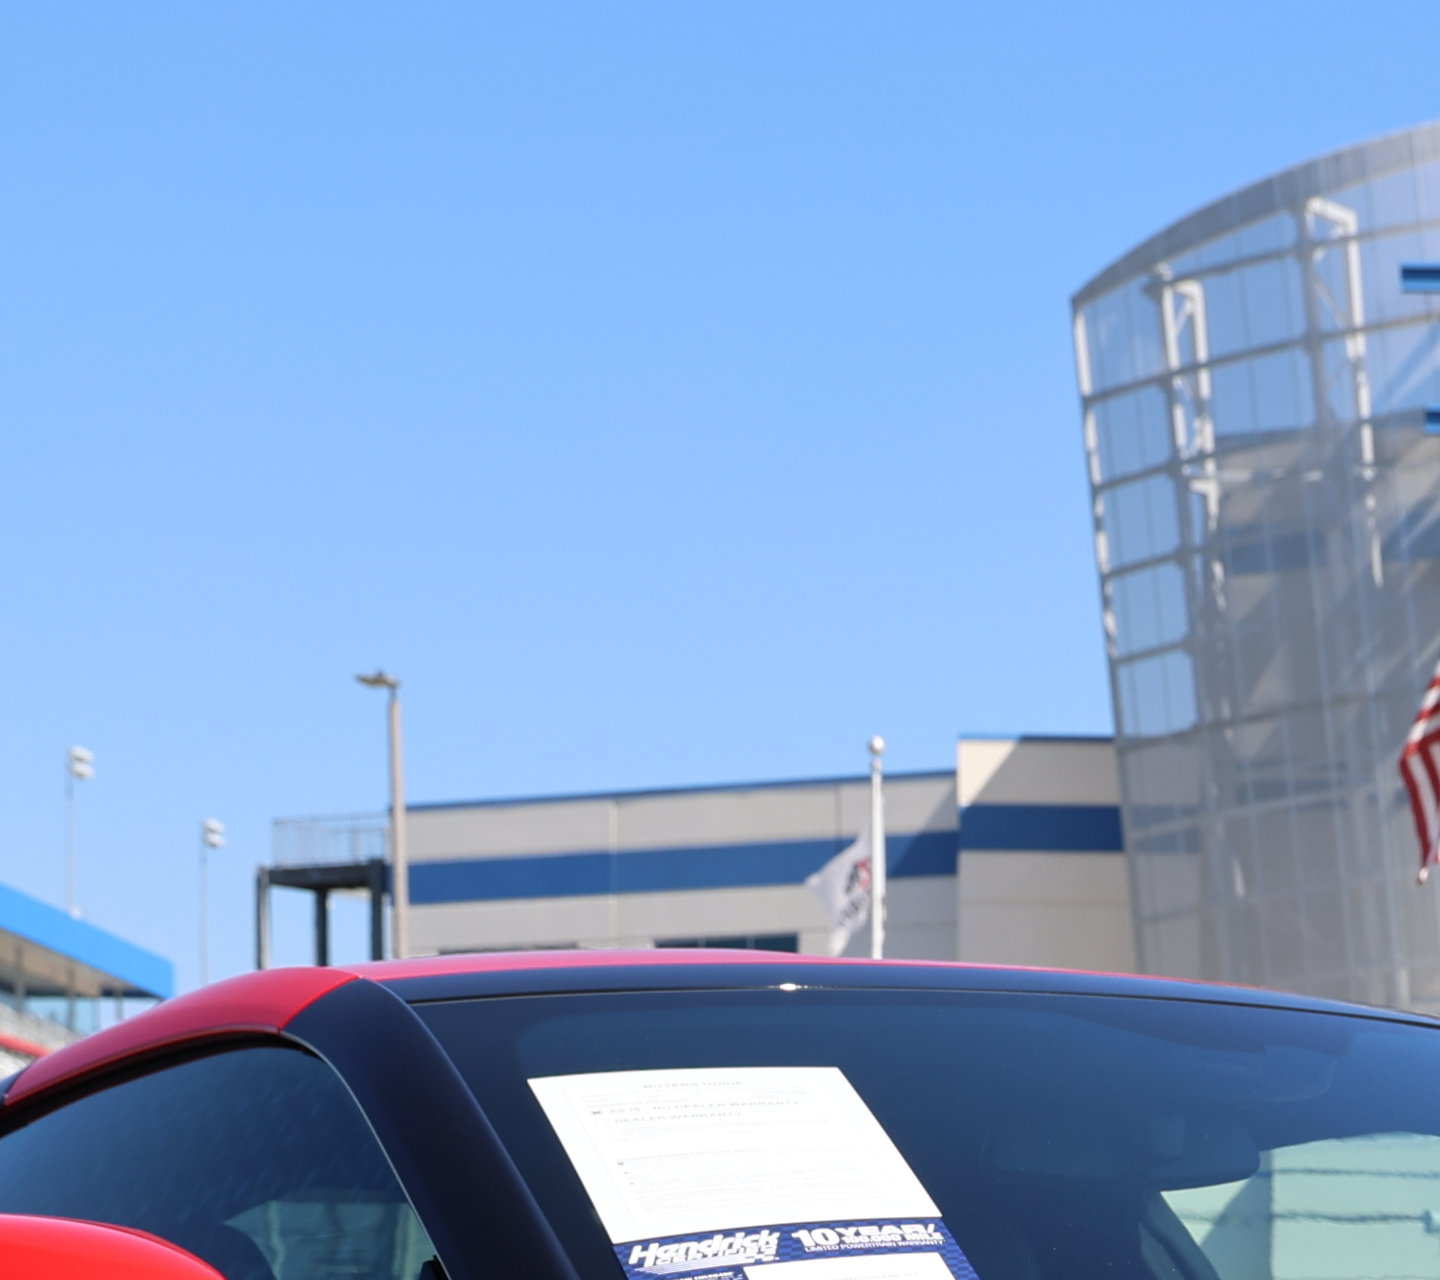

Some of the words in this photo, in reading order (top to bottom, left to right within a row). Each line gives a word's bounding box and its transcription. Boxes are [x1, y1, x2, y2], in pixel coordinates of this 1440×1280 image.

[791, 1227, 840, 1247] 10
[904, 1231, 945, 1242] MILE
[628, 1229, 781, 1268] Hendrick
[804, 1243, 839, 1253] LIMITED
[840, 1240, 897, 1250] POWERTRAIN
[897, 1238, 945, 1247] WARRANTY
